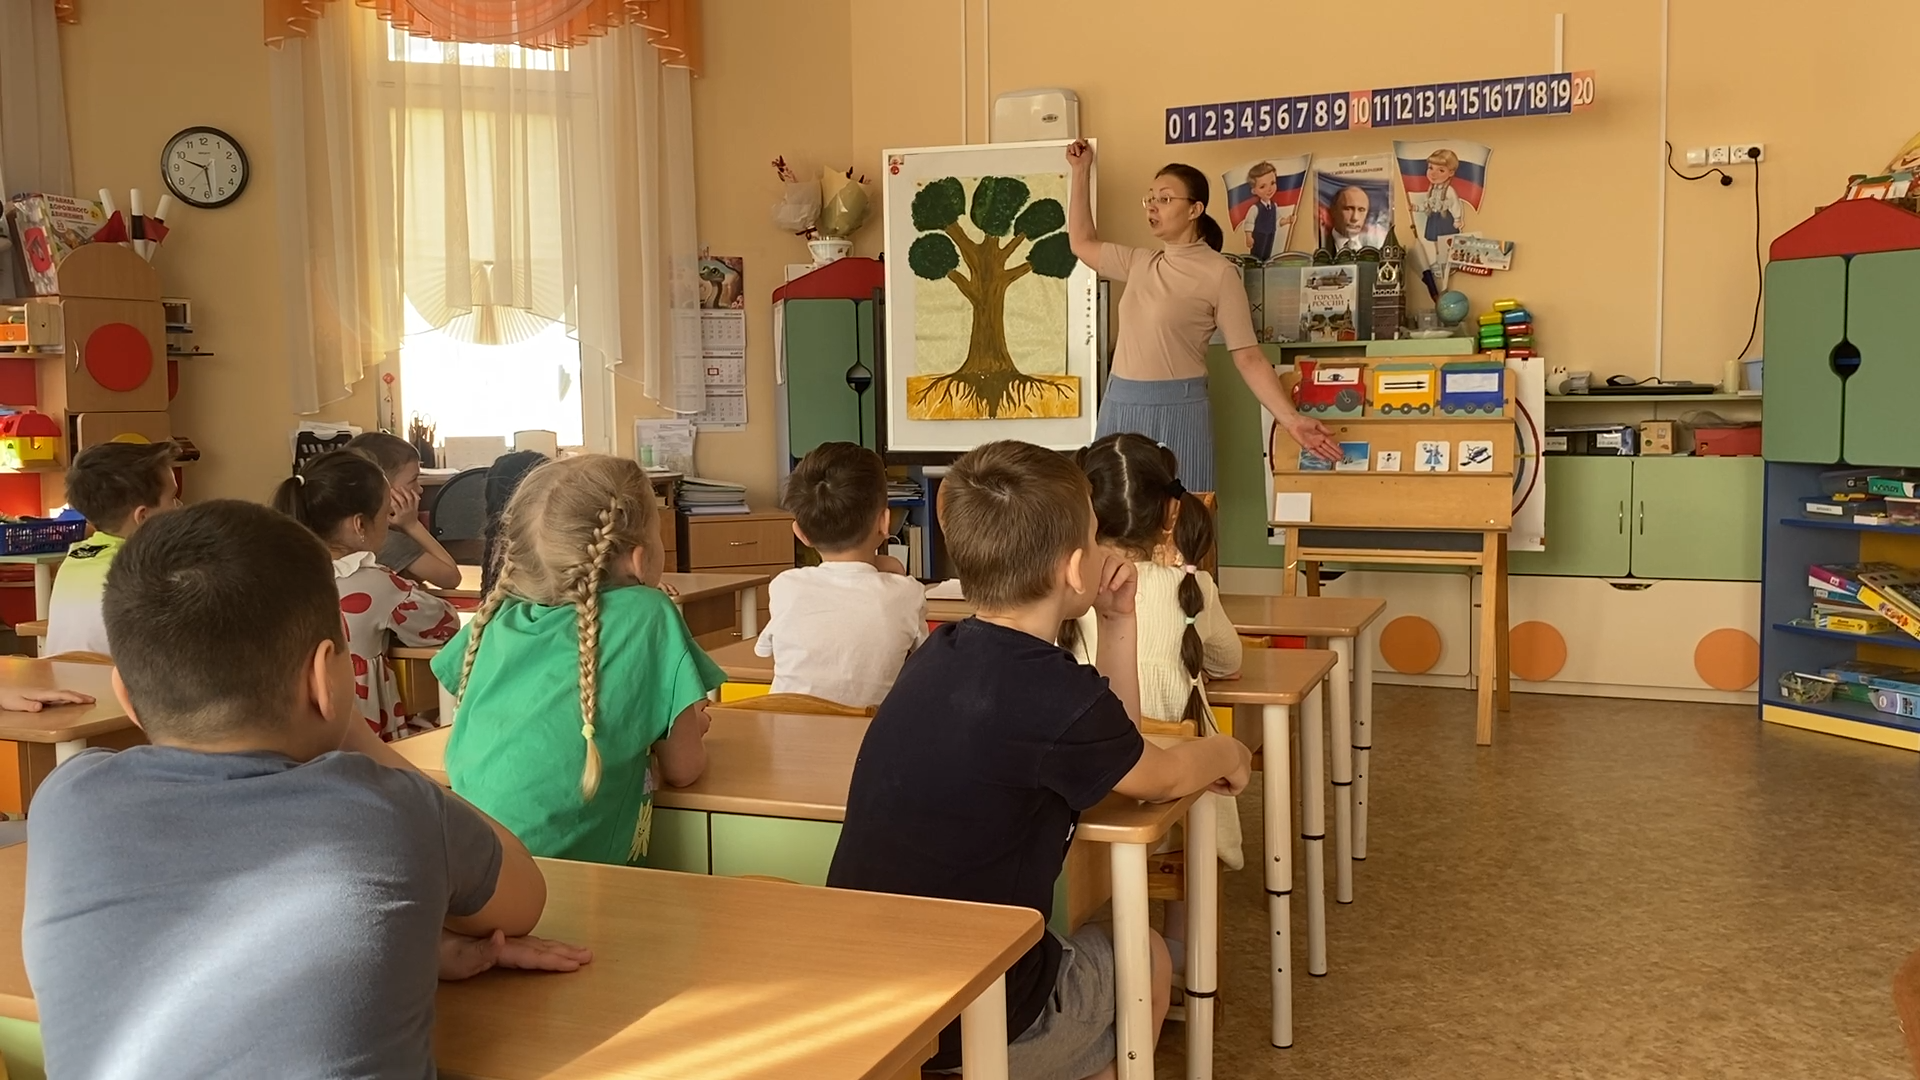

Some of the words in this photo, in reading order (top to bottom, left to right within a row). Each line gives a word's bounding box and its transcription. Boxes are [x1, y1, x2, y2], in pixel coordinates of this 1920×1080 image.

[1169, 114, 1181, 139] 0
[1188, 112, 1196, 137] 1
[1205, 110, 1217, 136] 2
[1223, 109, 1235, 135] 3
[1241, 107, 1253, 133] 4
[1259, 105, 1271, 131] 5
[1277, 103, 1290, 130] 6
[1296, 102, 1309, 128] 7
[1315, 100, 1328, 127] 8
[1333, 98, 1346, 125] 9
[1352, 97, 1370, 124] 10
[1373, 95, 1390, 122] 11
[1394, 93, 1413, 120] 12
[1416, 91, 1435, 118] 13
[1438, 89, 1457, 116] 14
[1460, 87, 1479, 114] 15
[1483, 85, 1502, 112] 16
[1505, 83, 1525, 111] 17
[1528, 81, 1548, 109] 18
[1550, 79, 1571, 107] 19
[1573, 77, 1594, 106] 20
[186, 141, 193, 149] 11
[199, 137, 208, 146] 12
[216, 141, 221, 149] 1
[176, 151, 186, 160] 10
[225, 151, 232, 160] 2
[173, 163, 180, 172] 9
[230, 164, 237, 173] 3
[178, 177, 185, 186] 8
[228, 178, 234, 186] 4
[189, 186, 196, 195] 7
[204, 190, 210, 199] 6
[218, 187, 225, 196] 5
[49, 203, 89, 214] ДОРОЖНОГО
